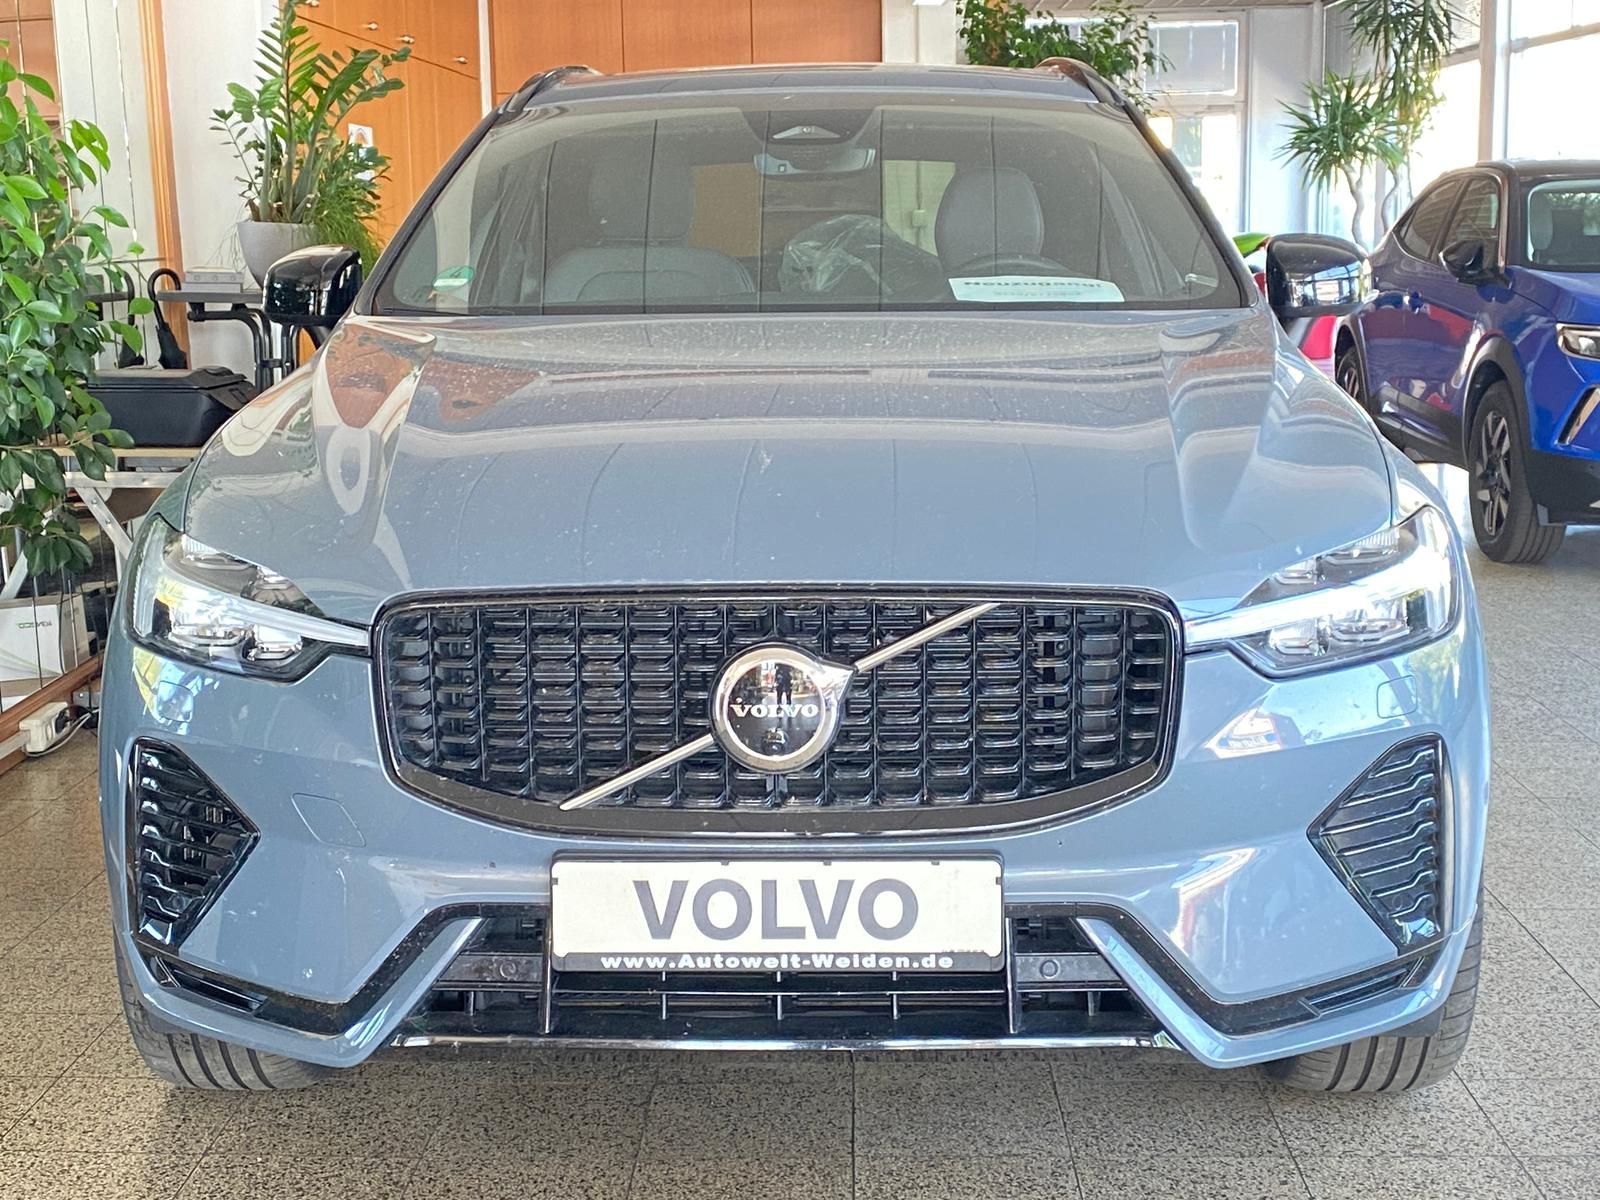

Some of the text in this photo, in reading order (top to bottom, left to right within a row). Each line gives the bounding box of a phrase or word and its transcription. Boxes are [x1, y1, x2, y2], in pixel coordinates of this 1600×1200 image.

[730, 704, 819, 718] VOLVO
[632, 878, 919, 941] VOLVO
[600, 953, 954, 969] www.Autowelt-Weiden.de
